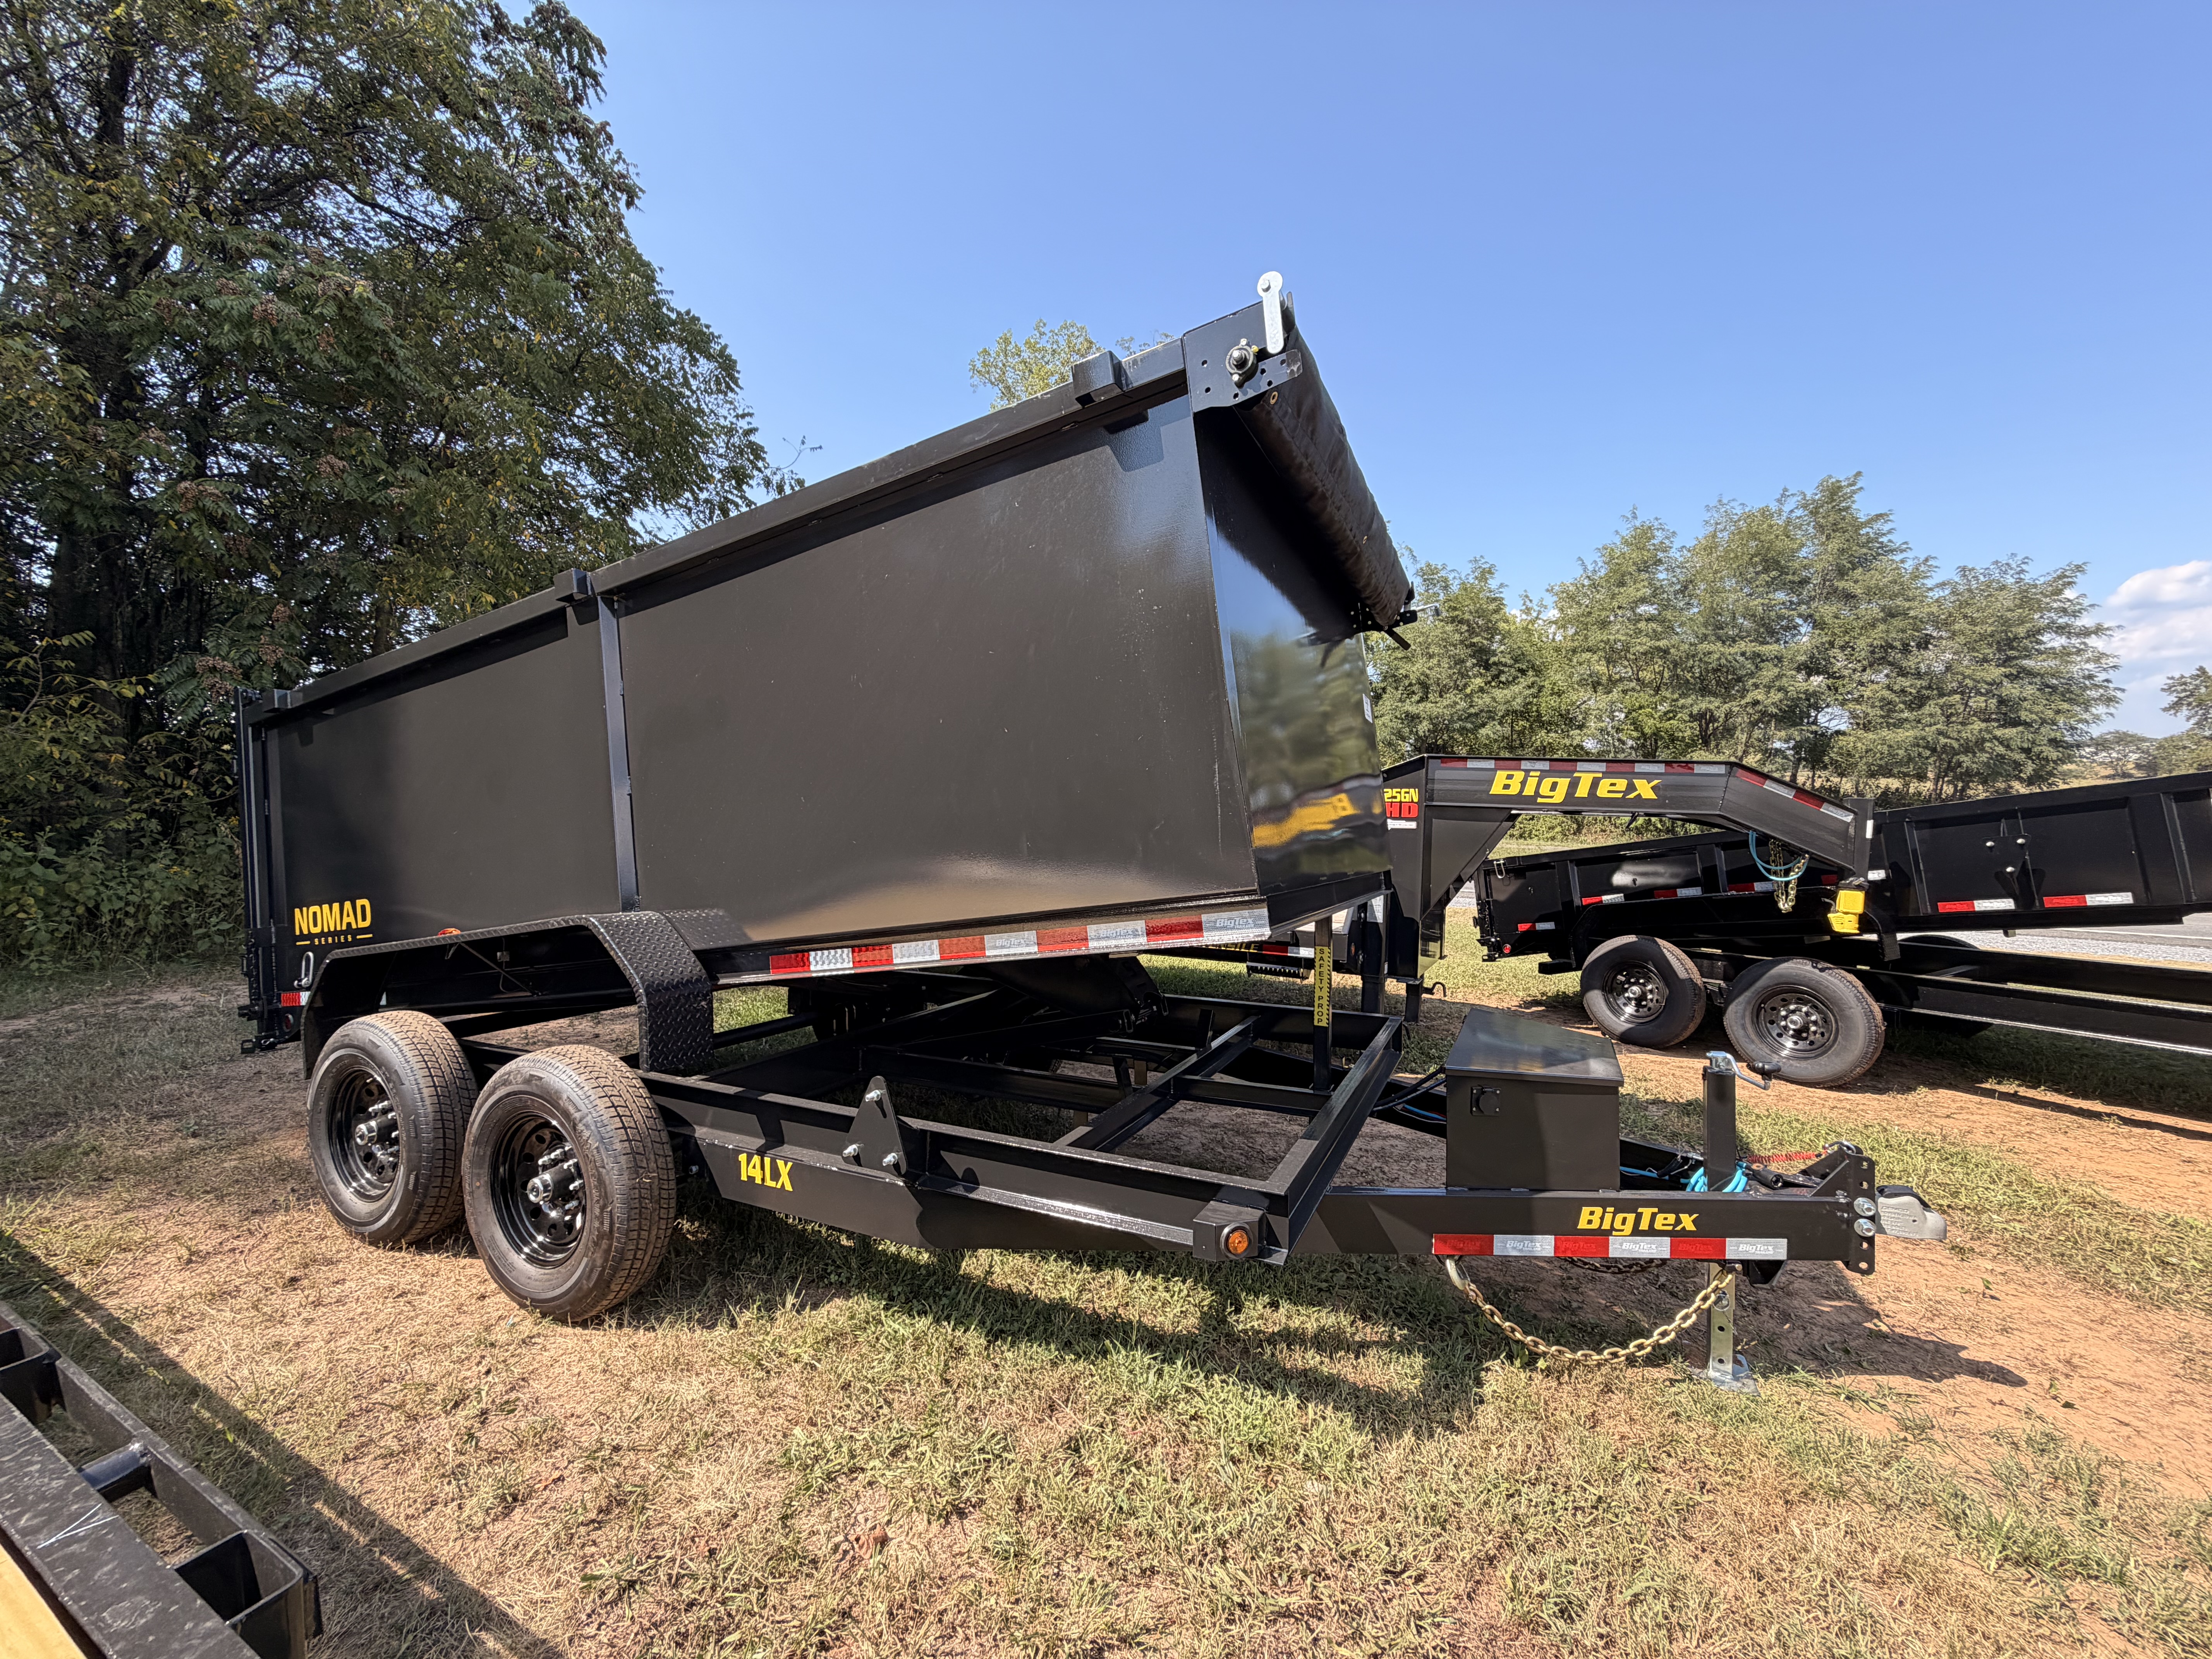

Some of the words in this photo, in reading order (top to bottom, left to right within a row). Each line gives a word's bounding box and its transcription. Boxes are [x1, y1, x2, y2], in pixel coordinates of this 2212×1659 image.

[1489, 770, 1662, 803] BigTex
[1384, 788, 1419, 802] 25GN
[1385, 802, 1419, 818] HD
[294, 898, 371, 936] NOMAD
[1216, 917, 1254, 927] BigTex
[314, 934, 352, 945] SERIES
[996, 938, 1027, 947] BigTex
[738, 1153, 793, 1192] 14LX
[1577, 1207, 1699, 1236] BigTex
[1506, 1240, 1542, 1249] BigTex
[1622, 1242, 1657, 1251] BigTex
[1739, 1244, 1774, 1253] BigTex
